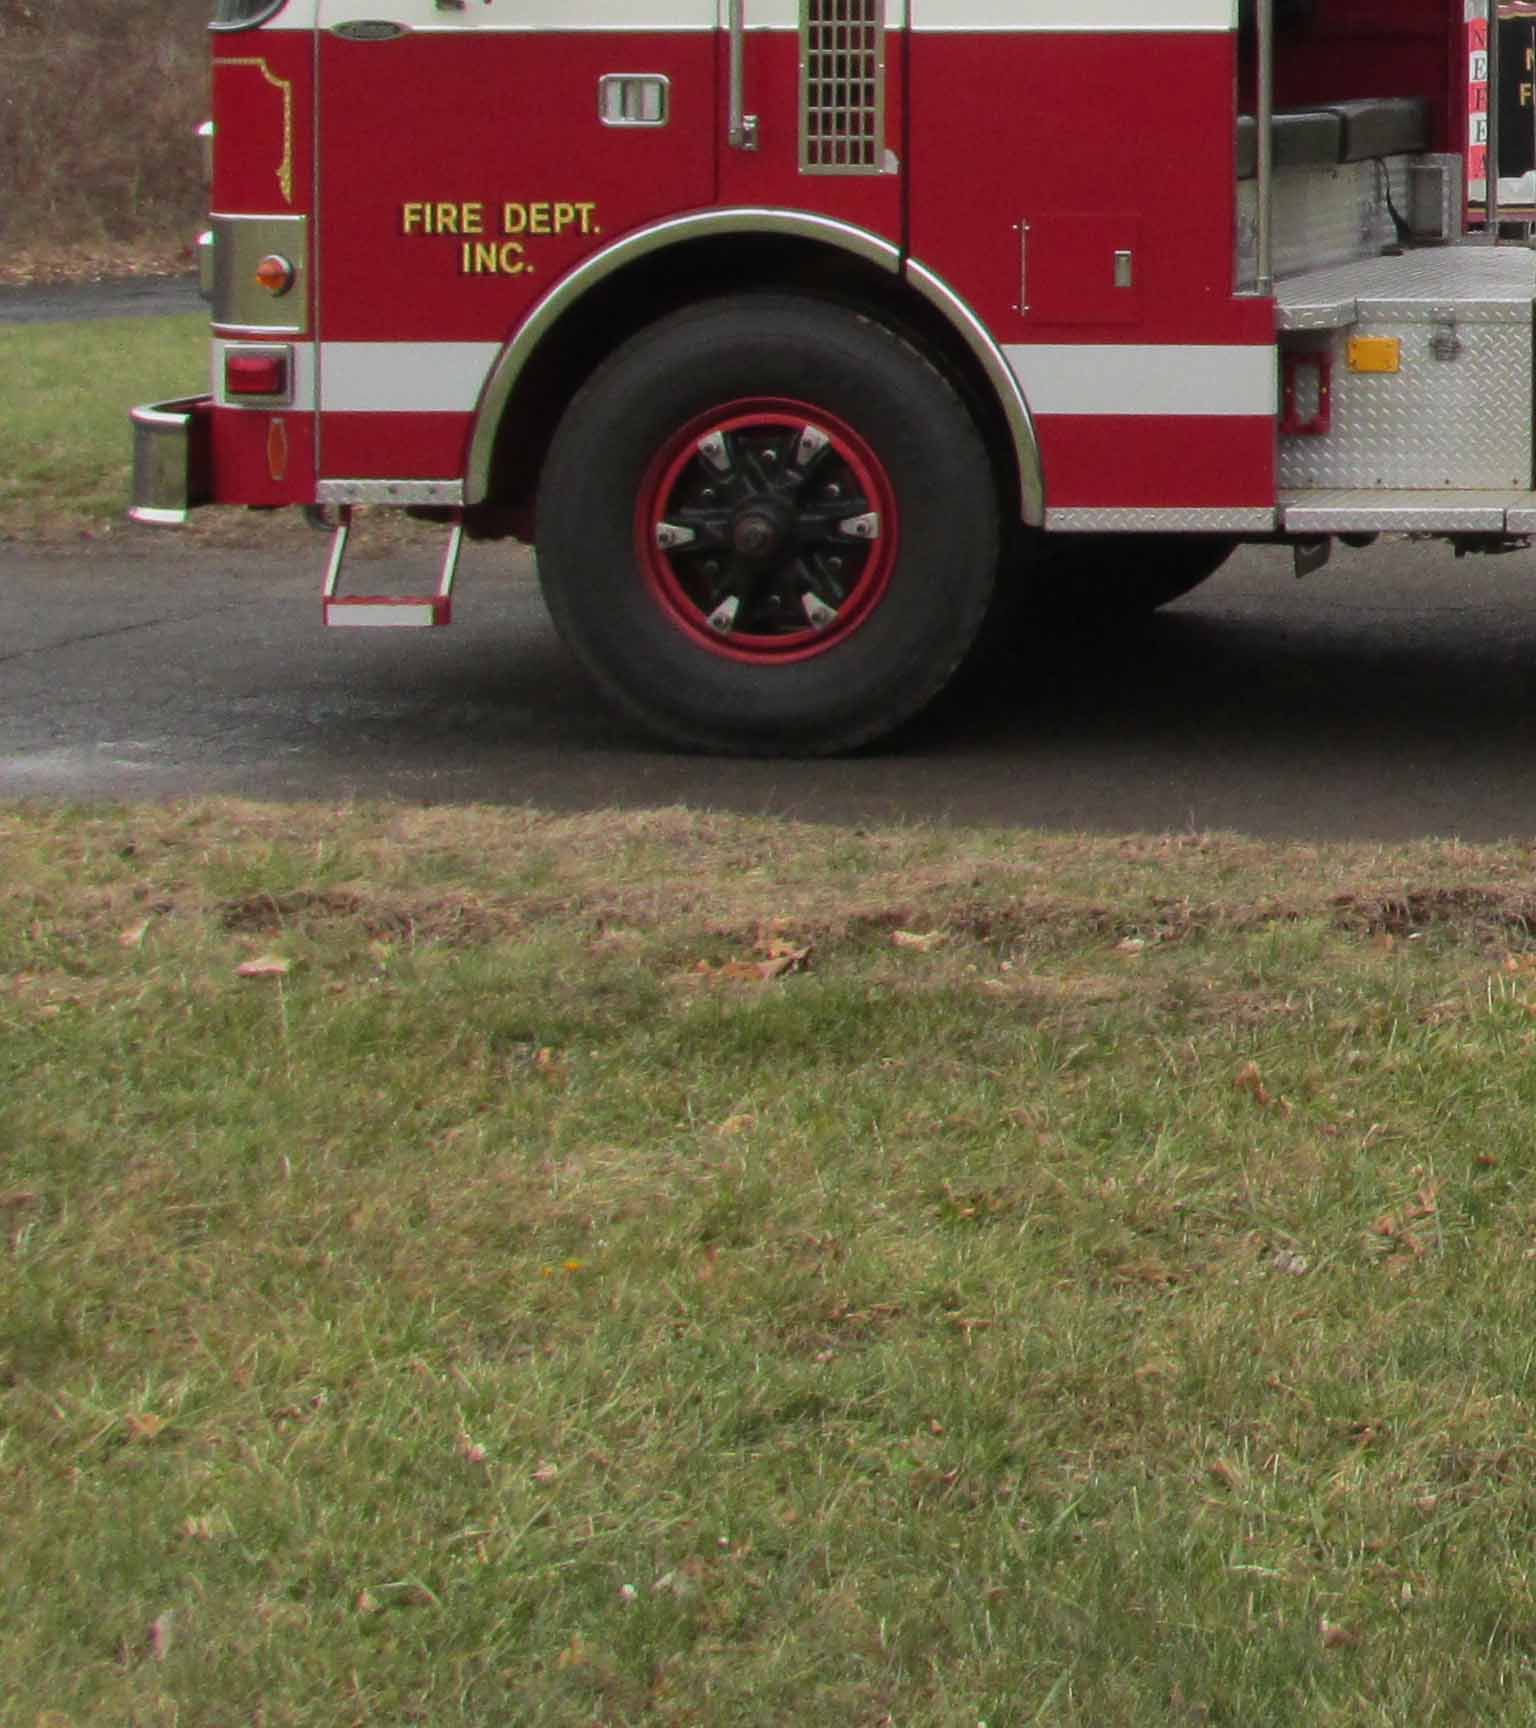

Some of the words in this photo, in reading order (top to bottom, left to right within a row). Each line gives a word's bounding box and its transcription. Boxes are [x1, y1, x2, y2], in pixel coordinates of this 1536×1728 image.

[402, 202, 483, 234] FIRE
[503, 202, 601, 234] DEPT.
[462, 241, 535, 274] INC.
